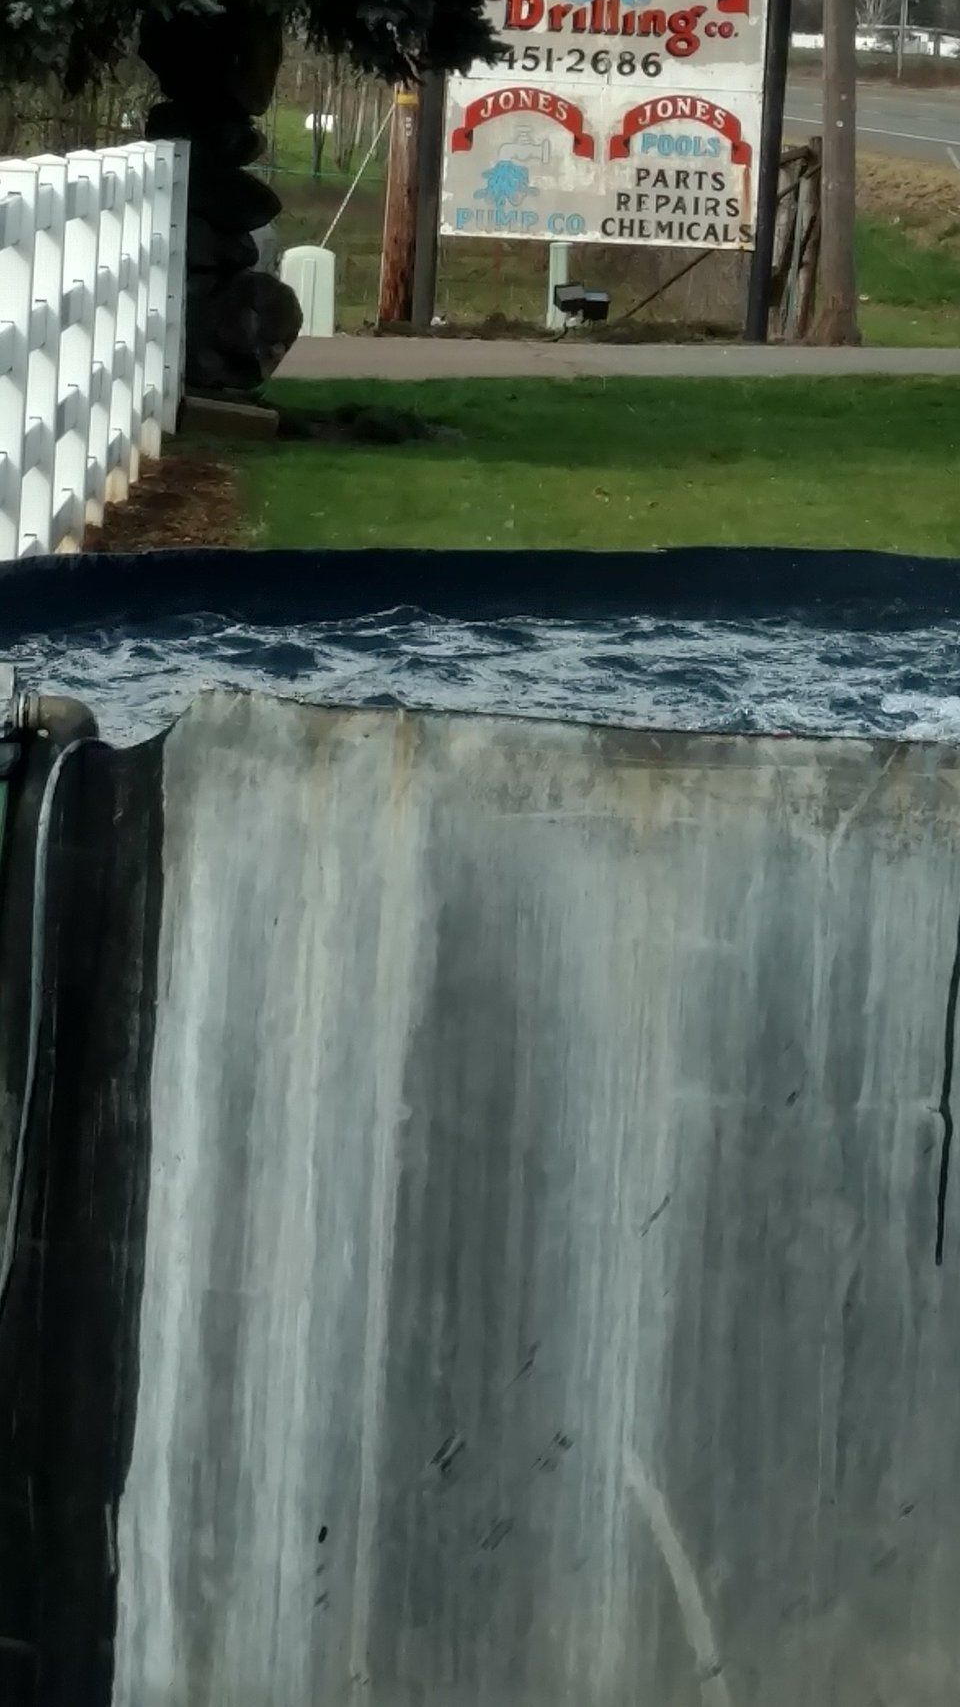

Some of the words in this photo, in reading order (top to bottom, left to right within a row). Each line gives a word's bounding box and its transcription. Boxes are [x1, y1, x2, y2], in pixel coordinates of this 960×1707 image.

[499, 45, 663, 78] 451-2686
[480, 90, 570, 122] JONES
[638, 97, 727, 130] JONES
[641, 132, 721, 157] POOLS
[635, 167, 727, 192] PARTS
[616, 192, 740, 218] REPAIRS
[455, 207, 540, 234] PUMP
[601, 217, 755, 243] CHEMICALS
